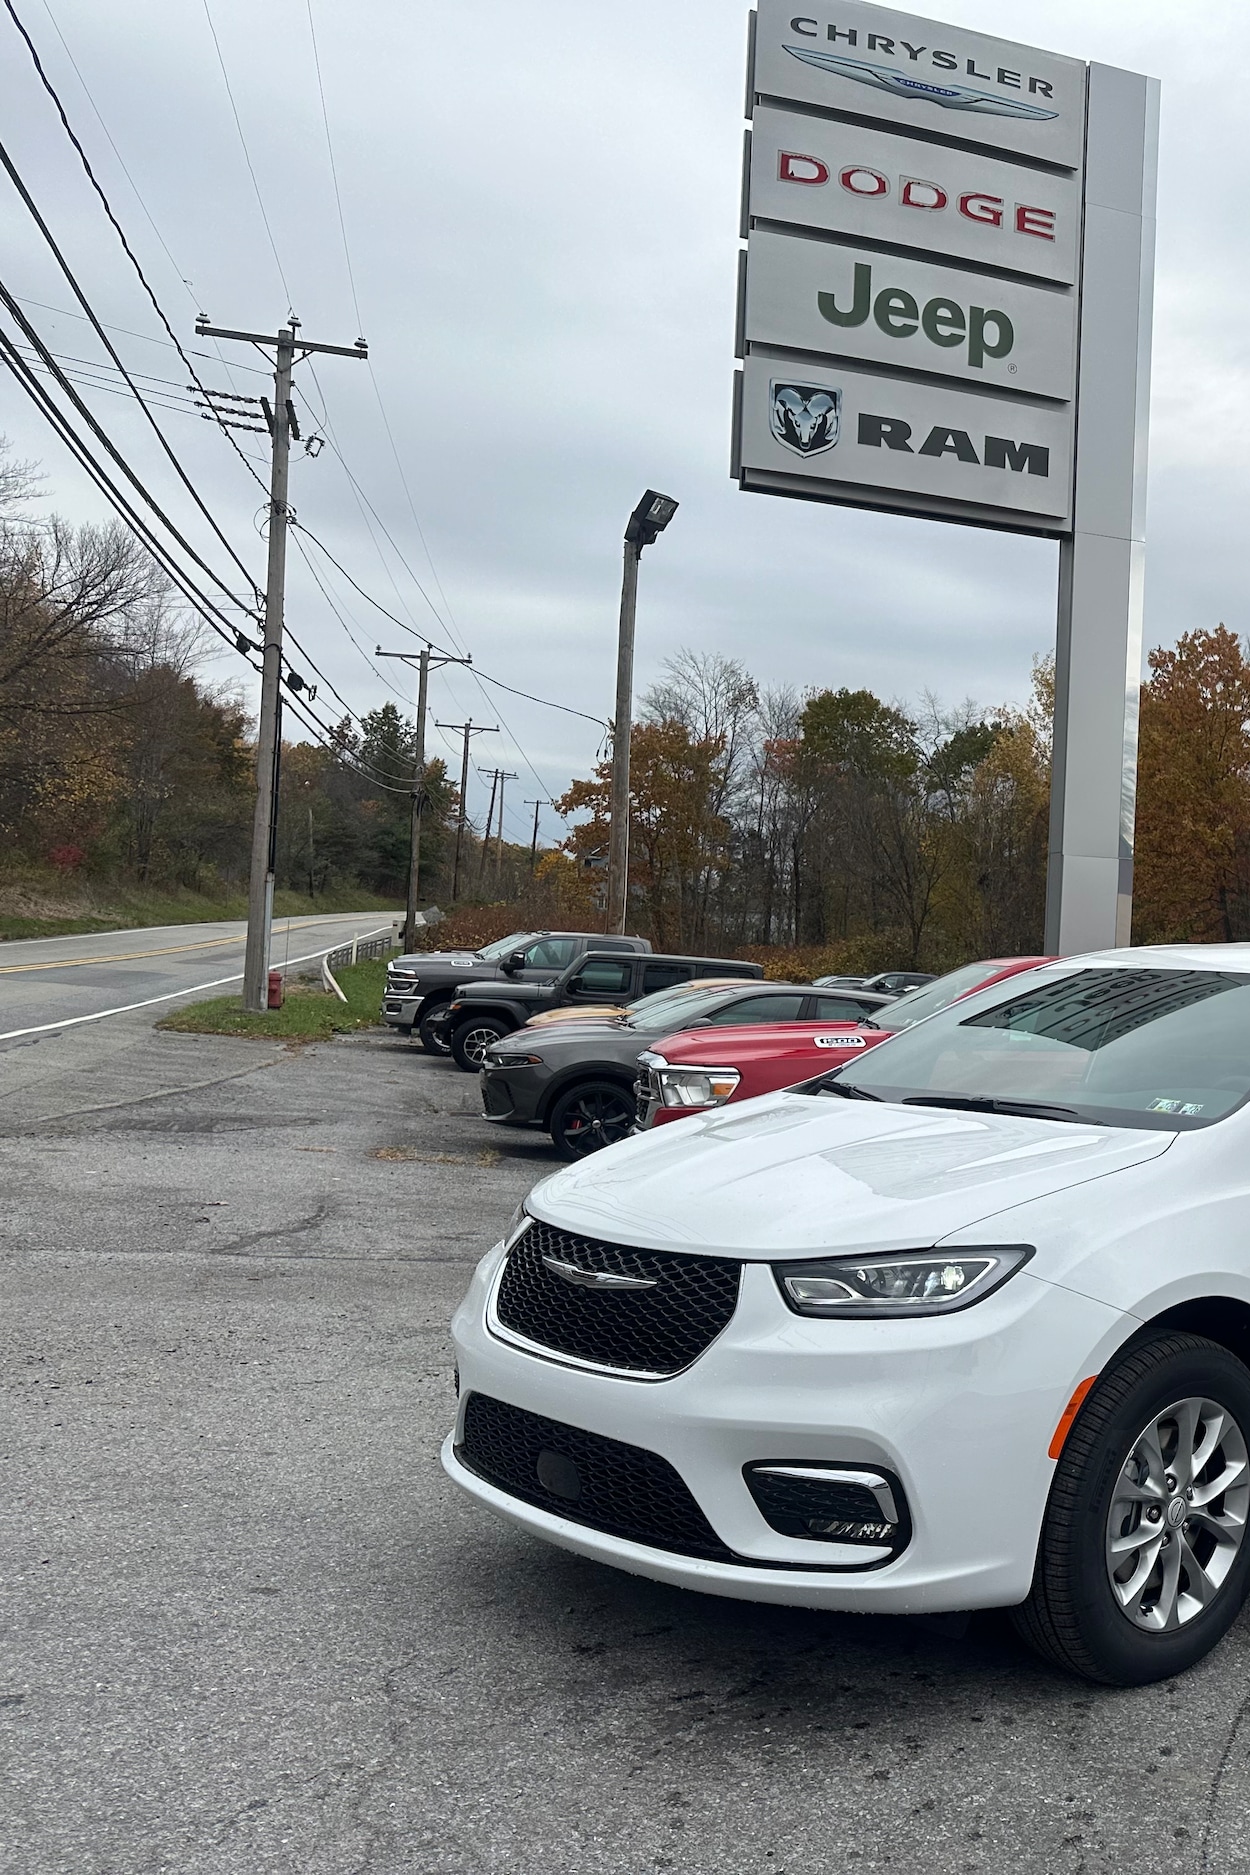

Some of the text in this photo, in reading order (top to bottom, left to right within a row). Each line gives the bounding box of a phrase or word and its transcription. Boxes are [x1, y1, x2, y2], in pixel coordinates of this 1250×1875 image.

[790, 17, 1054, 99] CHRYSLER
[777, 149, 1057, 243] DODGE
[817, 262, 1015, 369] Jeep
[857, 412, 1050, 478] RAM
